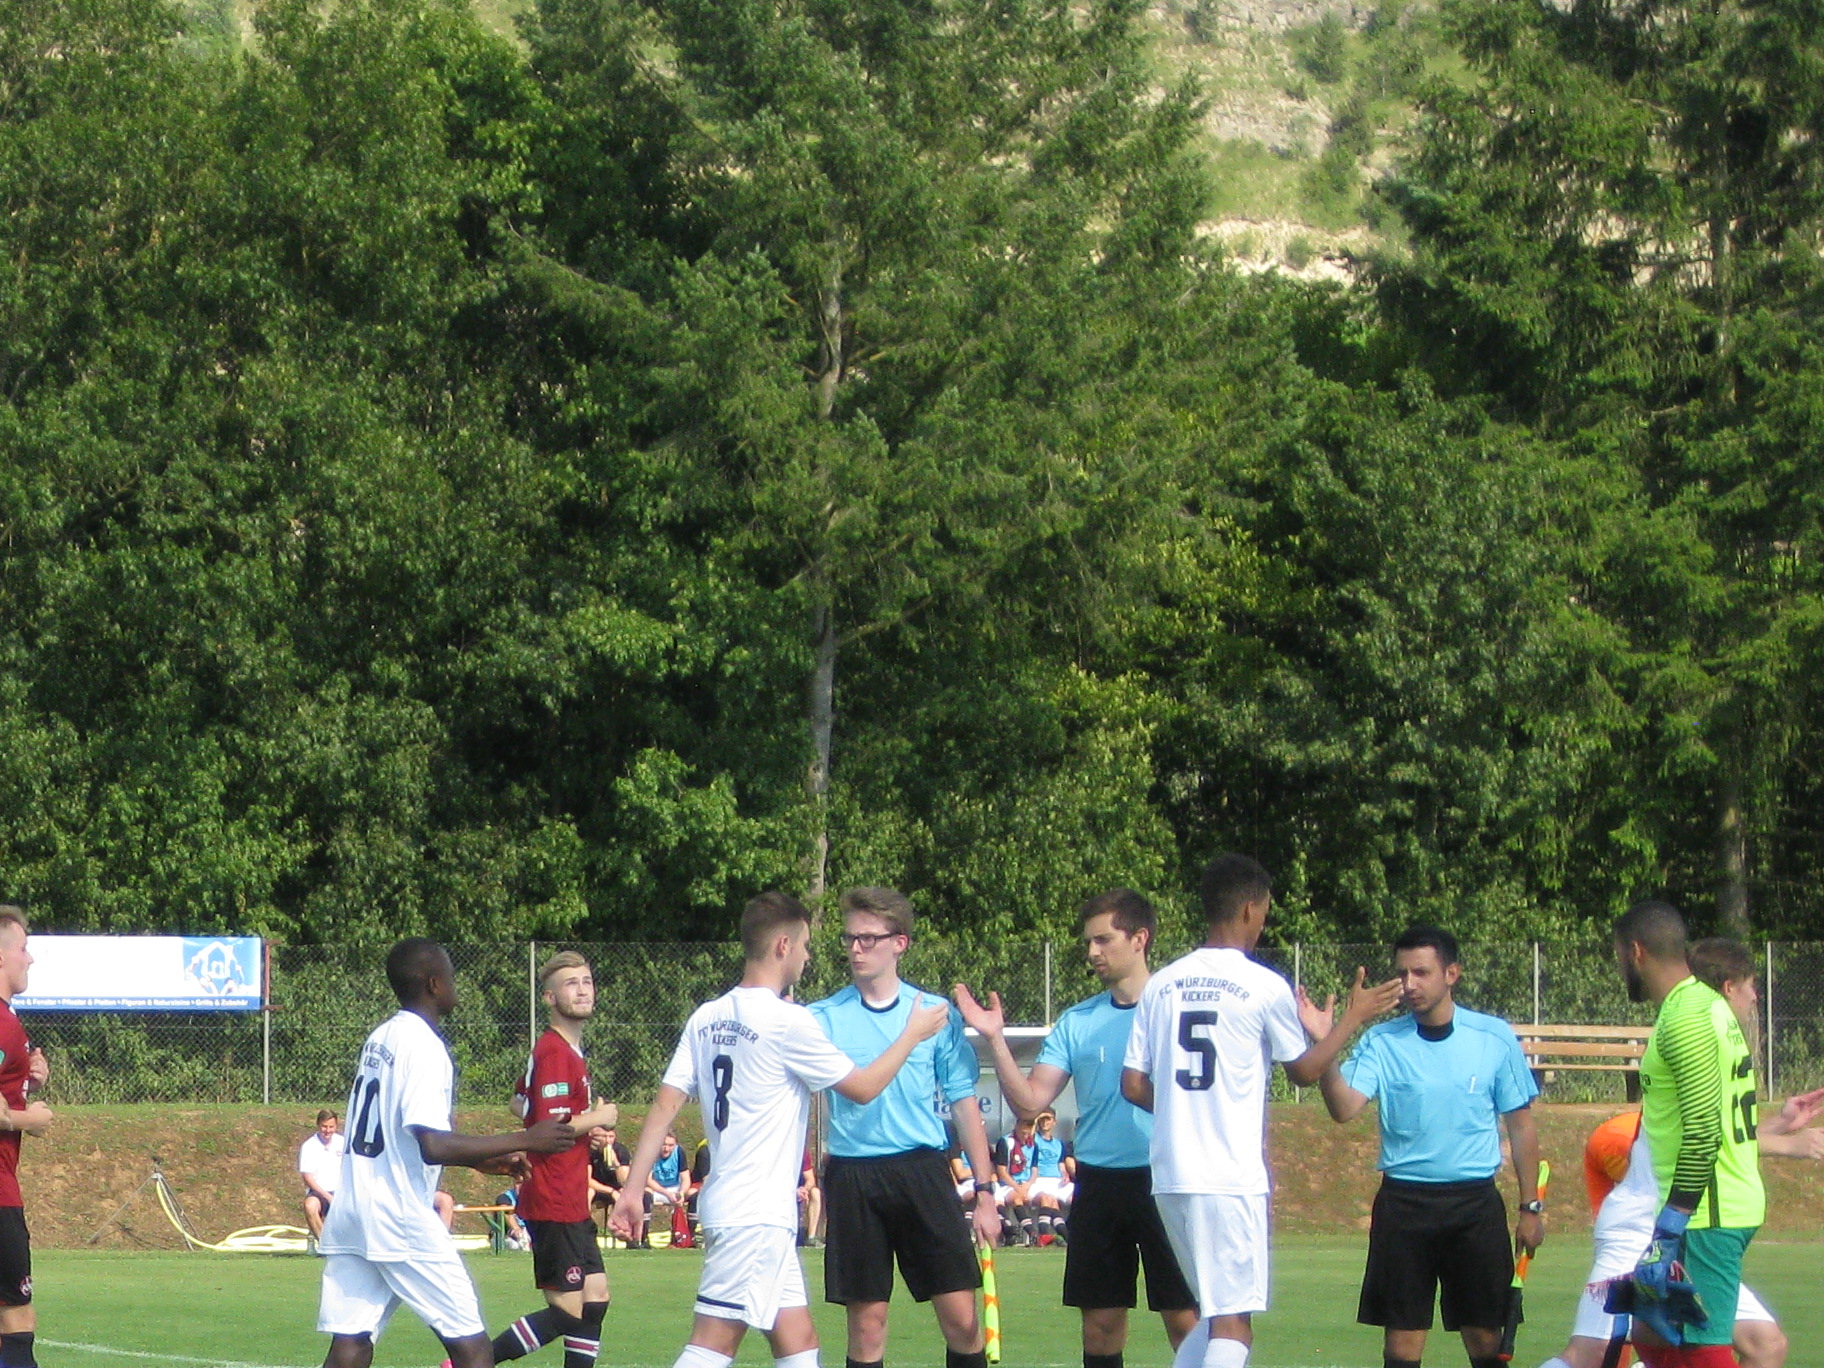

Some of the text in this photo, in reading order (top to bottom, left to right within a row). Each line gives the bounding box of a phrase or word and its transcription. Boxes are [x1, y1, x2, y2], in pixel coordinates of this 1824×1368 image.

[1159, 975, 1250, 1003] FC WÜRZBURGER
[1181, 990, 1222, 1002] KICKERS
[1175, 1010, 1219, 1092] 5
[345, 1074, 385, 1158] 10
[712, 1054, 734, 1132] 8
